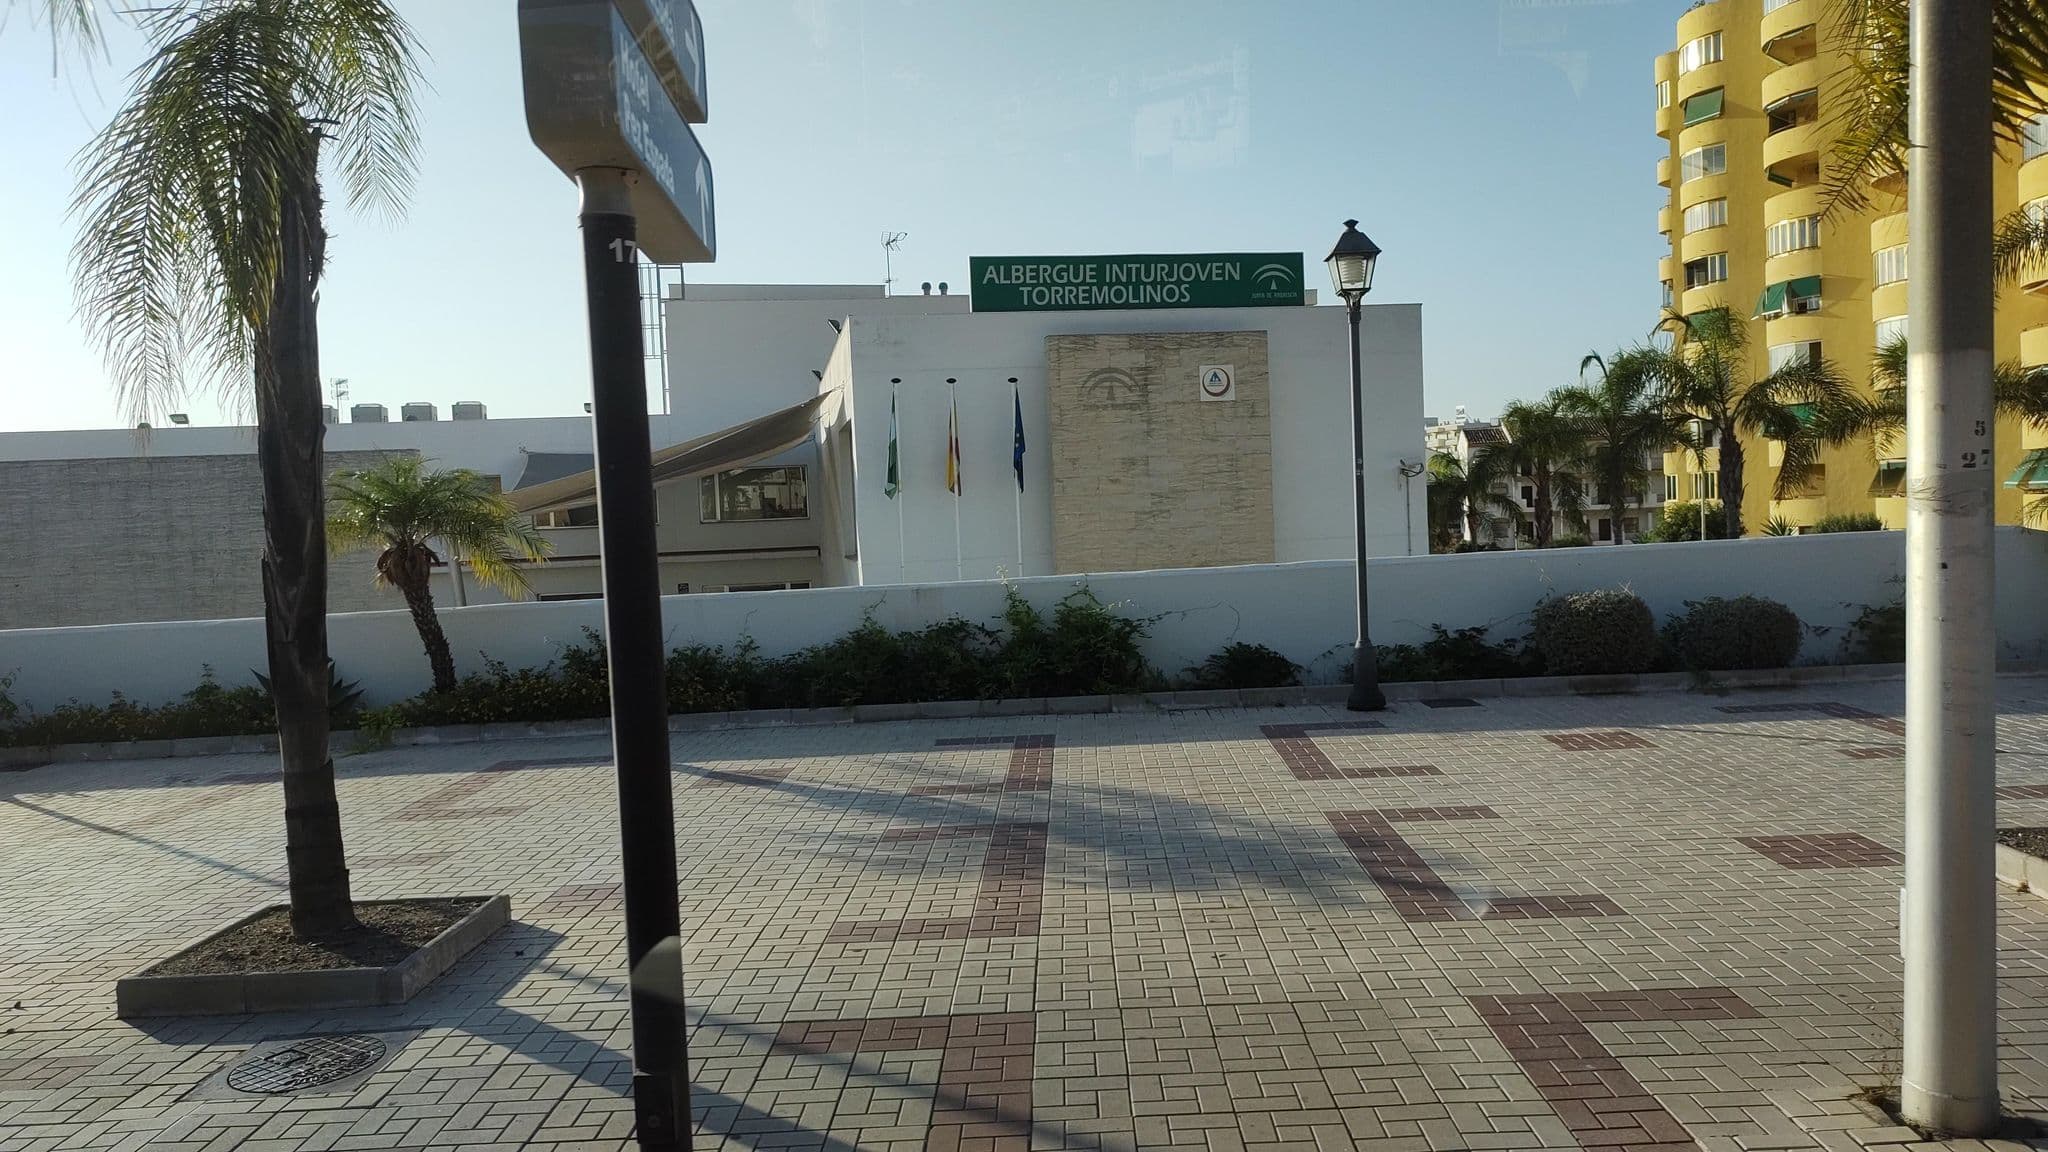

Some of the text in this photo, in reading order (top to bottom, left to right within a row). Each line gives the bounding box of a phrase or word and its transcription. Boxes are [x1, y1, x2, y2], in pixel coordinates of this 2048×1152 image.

[609, 238, 636, 263] 17
[982, 262, 1241, 285] ALBERGUE INTURJOVEN
[1019, 284, 1191, 306] TORREMOLINOS
[1961, 449, 1990, 468] 27
